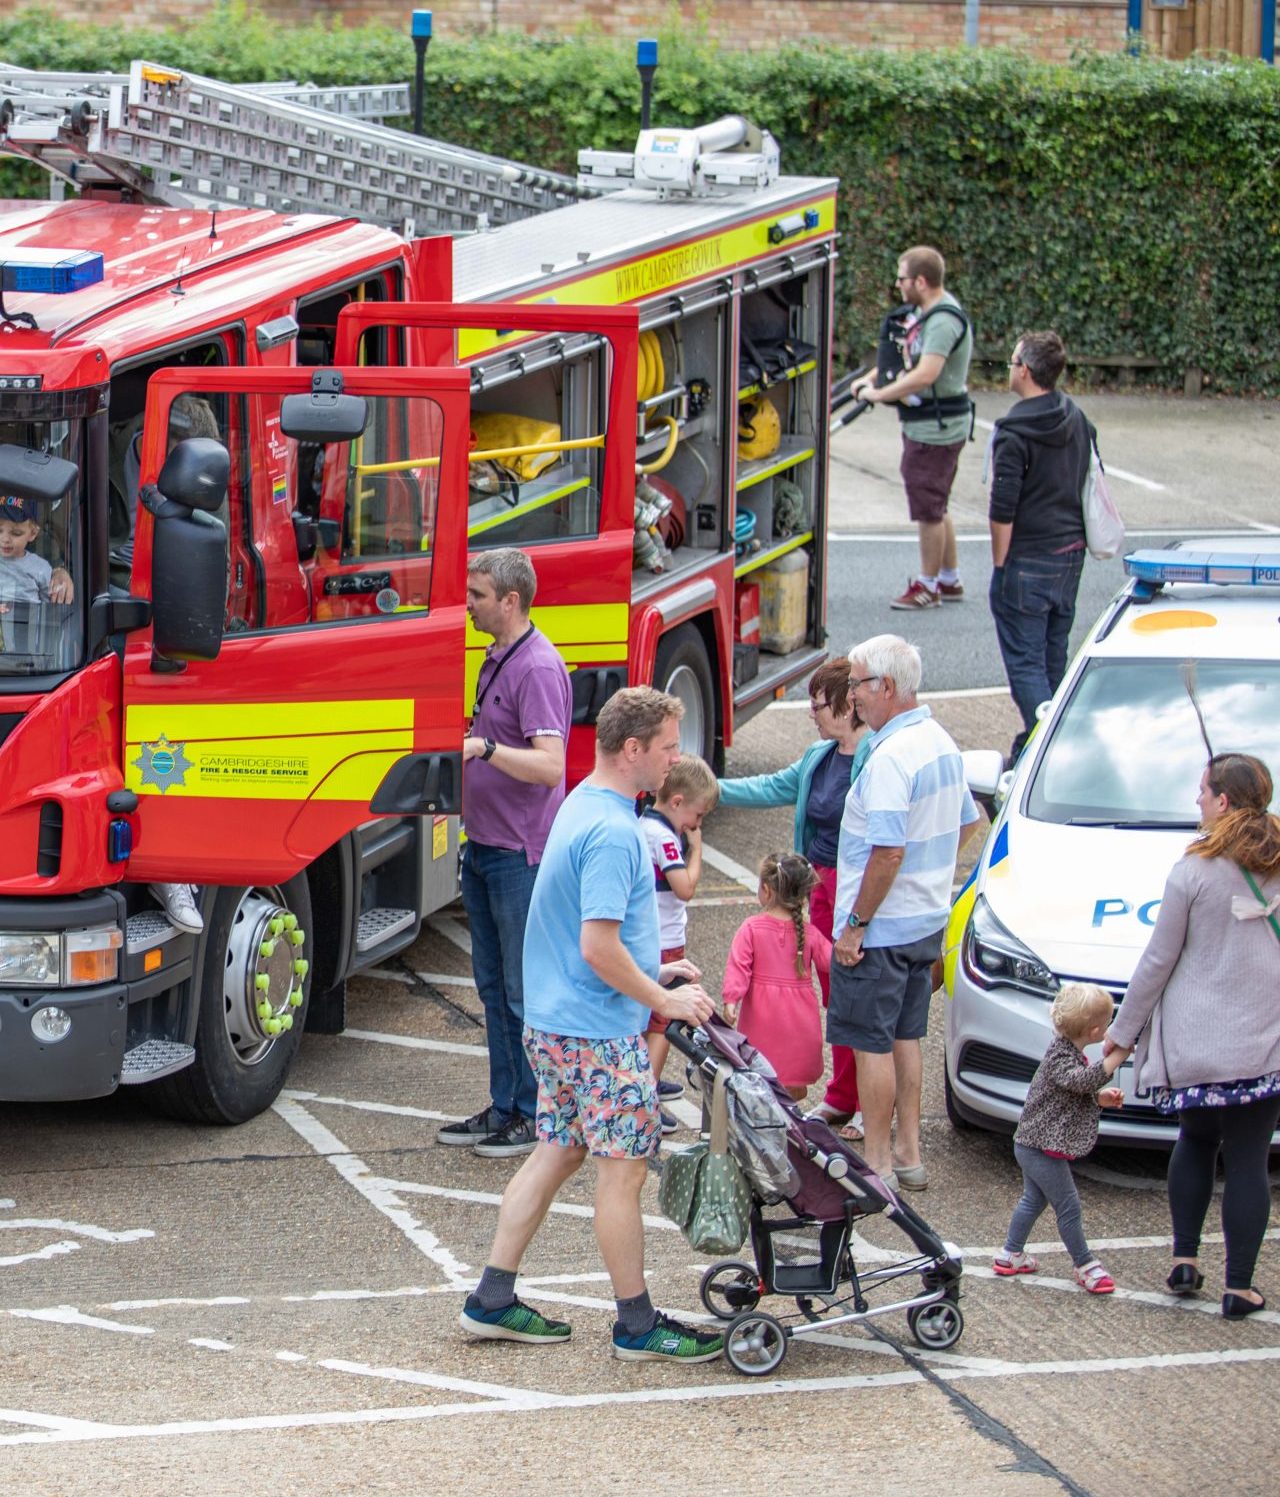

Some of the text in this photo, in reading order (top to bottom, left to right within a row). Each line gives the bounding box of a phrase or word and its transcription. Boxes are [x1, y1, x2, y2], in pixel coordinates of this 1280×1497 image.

[616, 239, 721, 295] WWW.CAMBSFIRE.GOV.UK
[200, 757, 309, 768] CAMBRIDGESHIRE
[662, 842, 679, 860] 5
